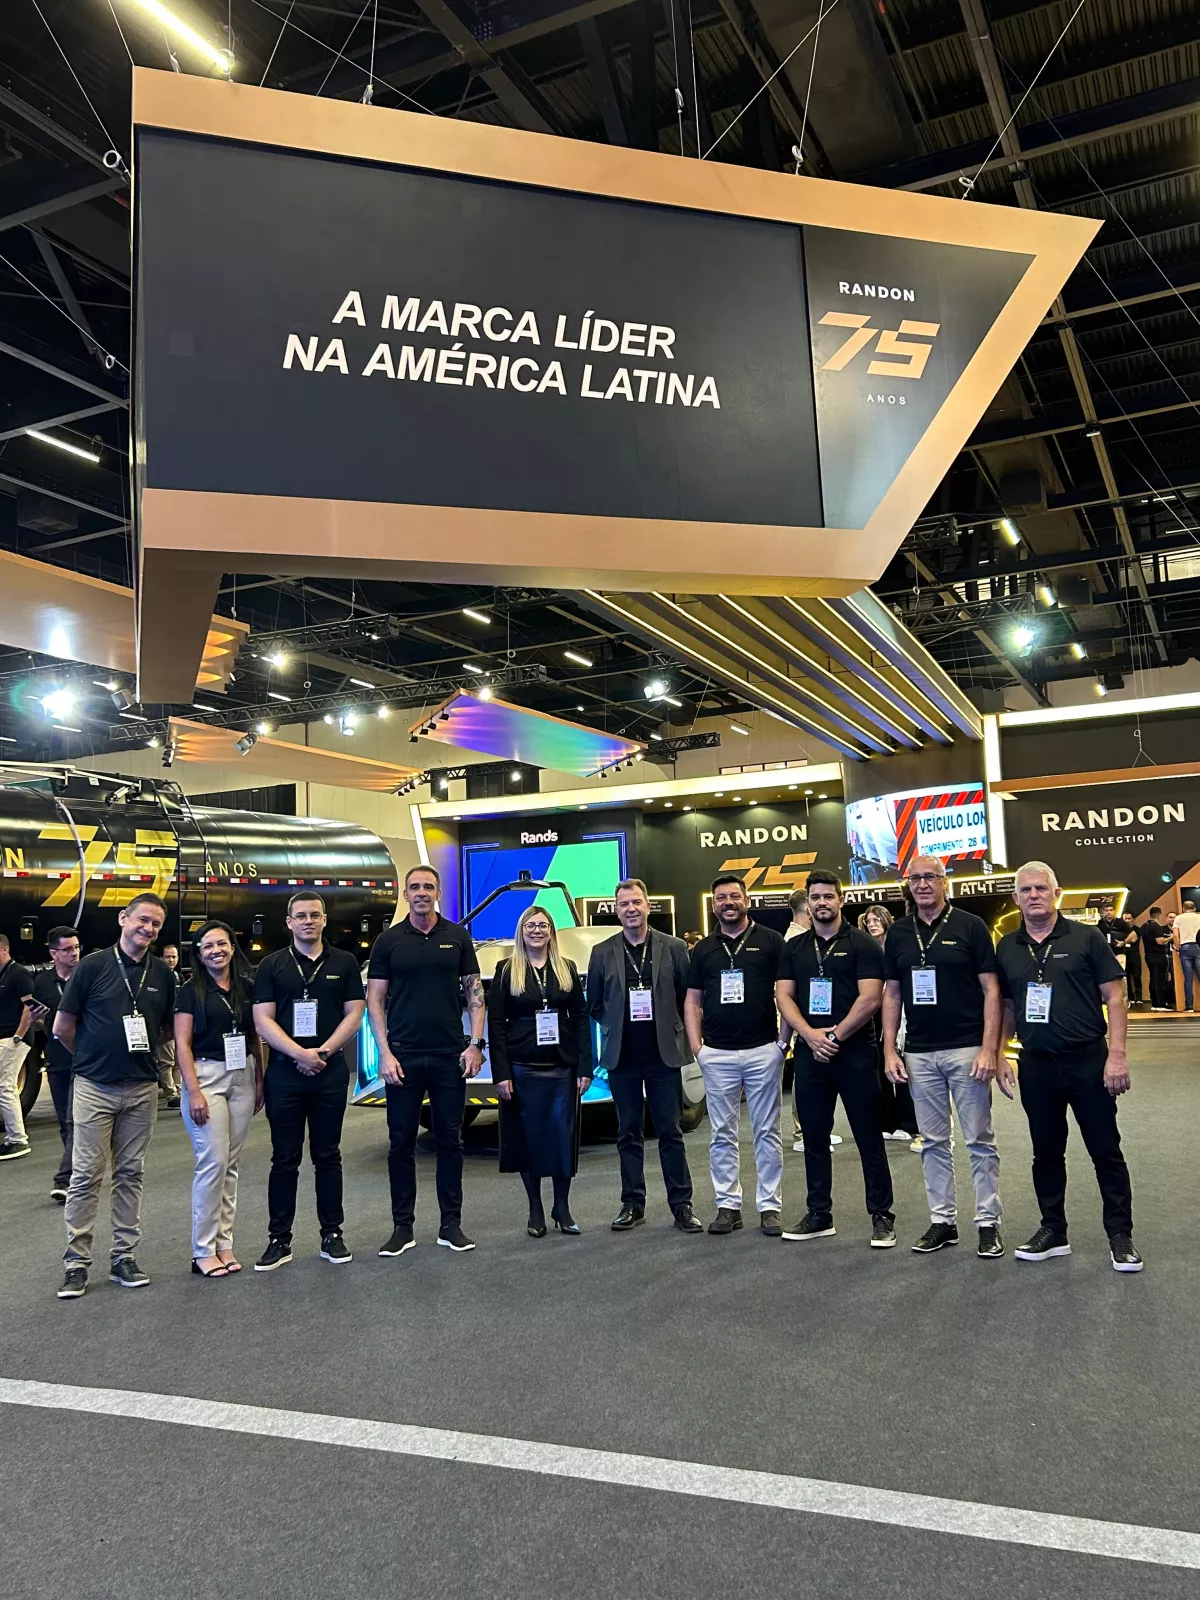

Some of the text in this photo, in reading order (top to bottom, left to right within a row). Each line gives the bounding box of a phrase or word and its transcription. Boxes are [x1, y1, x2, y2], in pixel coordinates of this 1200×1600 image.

[838, 281, 916, 302] RANDON
[332, 291, 676, 360] A MARCA LÍDER
[817, 311, 941, 379] 75
[282, 334, 721, 410] NA AMÉRICA LATINA
[866, 393, 907, 406] ANOS
[919, 813, 963, 834] VEÍCULO
[1042, 802, 1186, 832] RANDON
[520, 829, 559, 845] Rands
[699, 824, 808, 848] RANDON
[967, 837, 978, 848] 28
[1075, 834, 1155, 847] COLLECTION
[0, 822, 257, 907] N 75 ANOS
